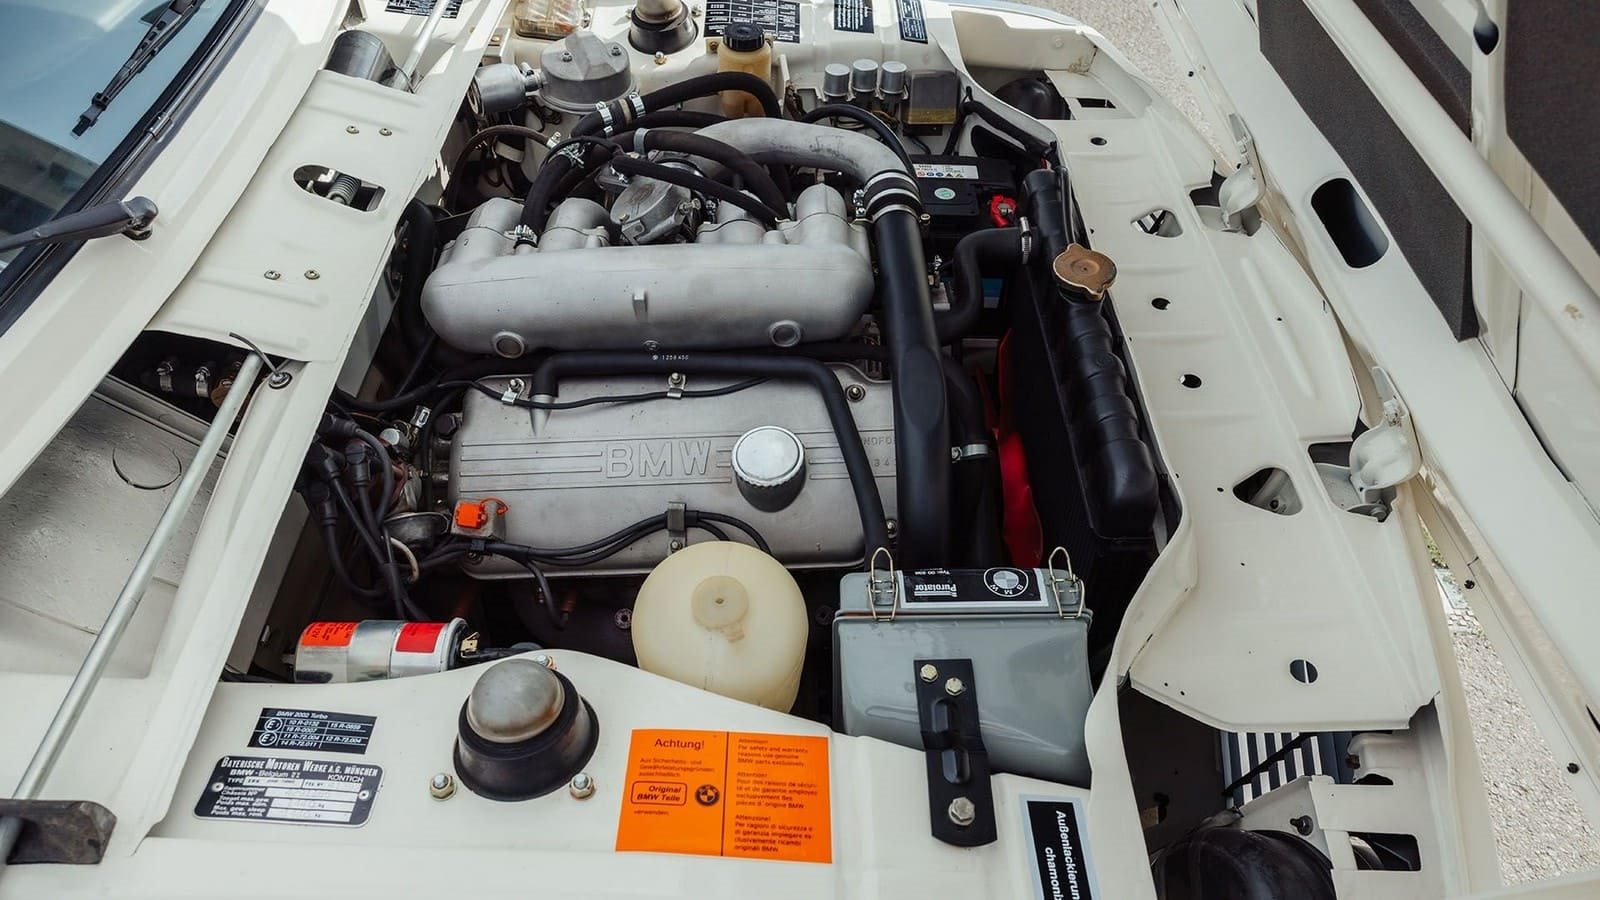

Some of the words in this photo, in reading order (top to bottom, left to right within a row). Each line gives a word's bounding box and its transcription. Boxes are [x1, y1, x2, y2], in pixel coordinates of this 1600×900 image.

[863, 436, 892, 446] NDFO
[606, 440, 711, 478] BMW
[914, 584, 956, 592] Purolator
[990, 584, 1024, 594] BMW
[654, 738, 704, 751] Achtung!
[258, 770, 288, 778] Belgium
[344, 764, 378, 776] MÜNCHEN
[328, 774, 364, 784] KONTICH
[648, 785, 682, 794] Original
[1056, 810, 1081, 900] Außenlackierun
